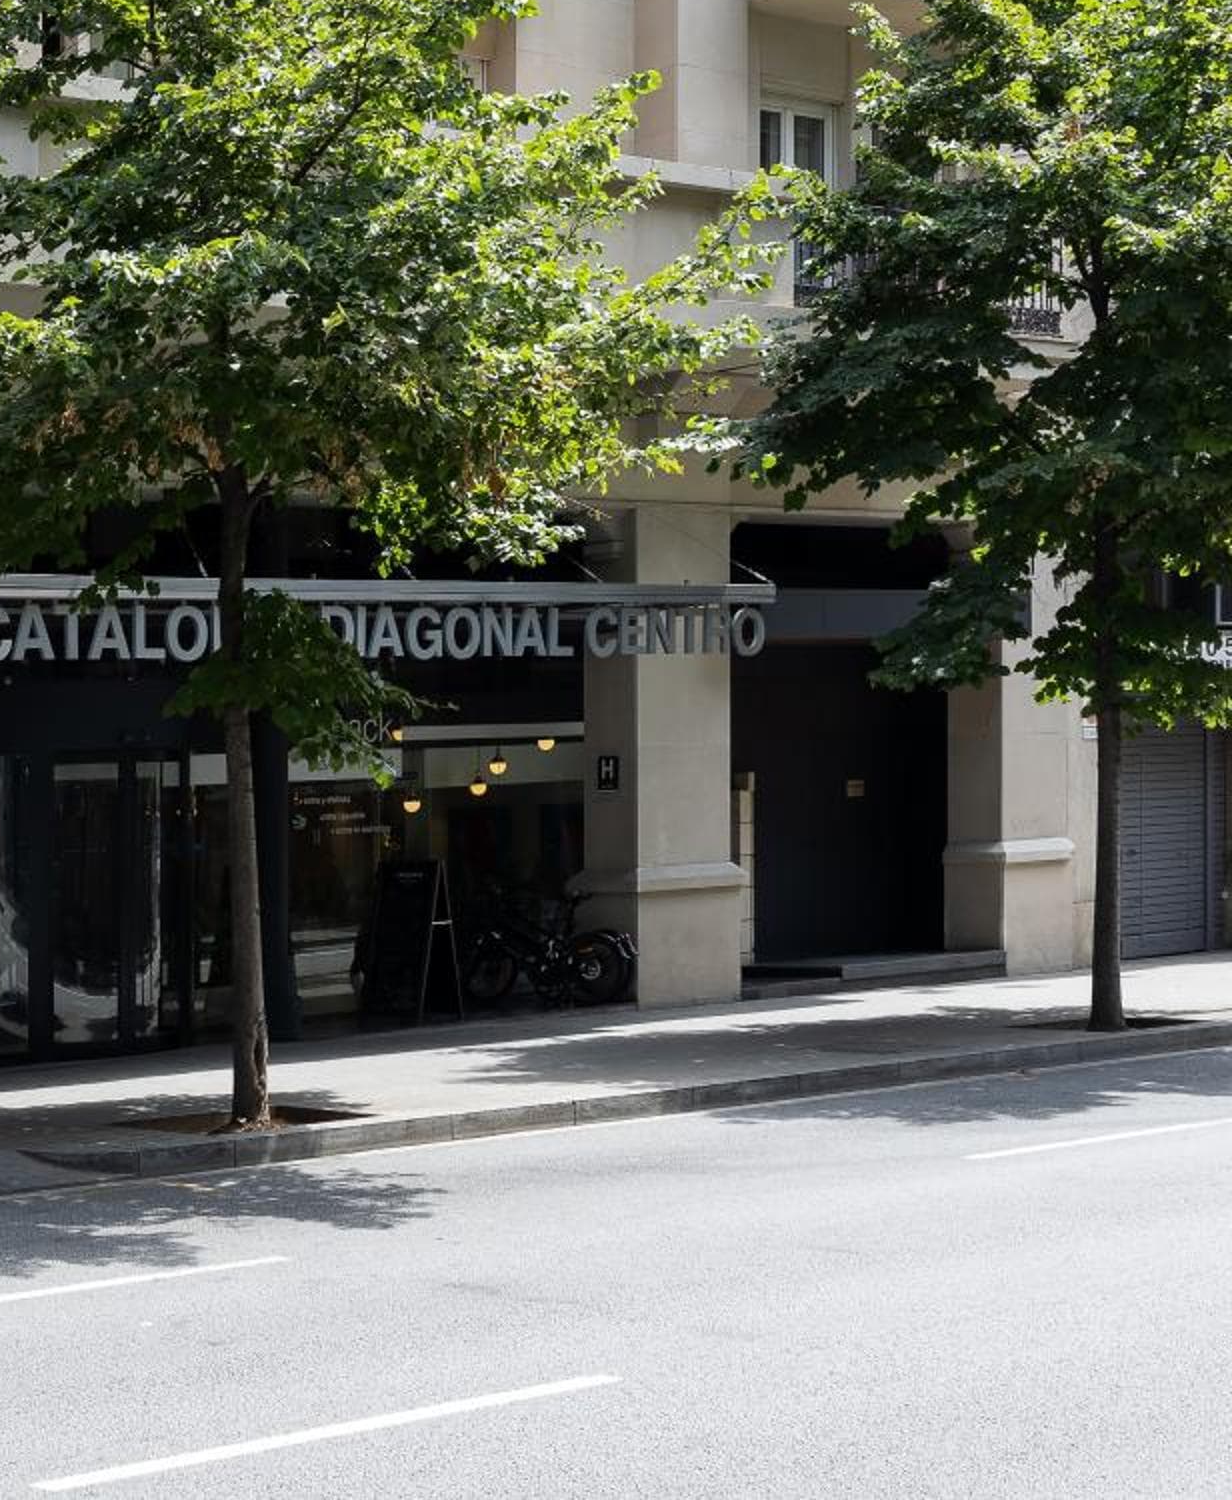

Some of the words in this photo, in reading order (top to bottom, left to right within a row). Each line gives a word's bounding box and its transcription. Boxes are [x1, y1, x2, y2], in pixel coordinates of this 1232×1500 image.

[320, 605, 574, 660] DIAGONAL
[585, 605, 766, 658] CENTRO
[600, 757, 614, 780] H
